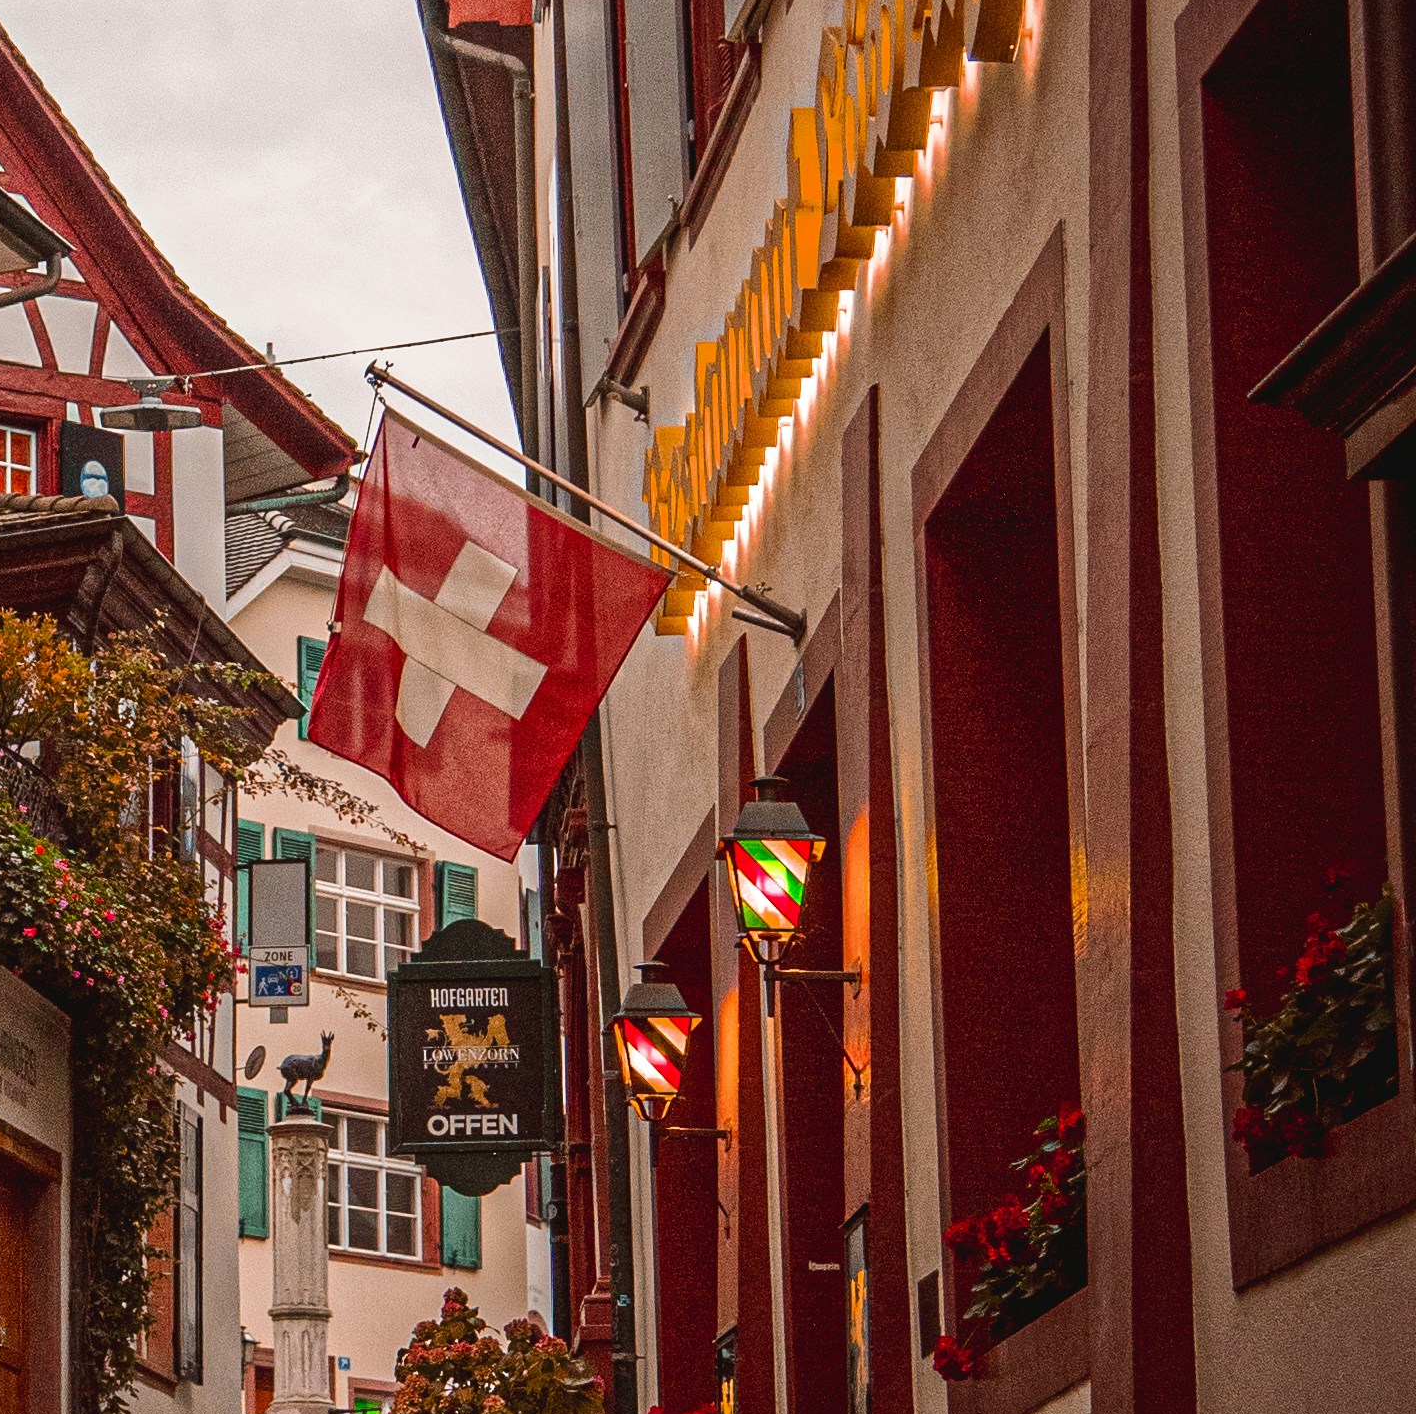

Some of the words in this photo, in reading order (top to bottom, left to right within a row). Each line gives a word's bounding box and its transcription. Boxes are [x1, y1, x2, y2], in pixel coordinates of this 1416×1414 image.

[264, 951, 293, 962] ZONE
[430, 987, 509, 1008] HOFGARTEN
[427, 1114, 519, 1136] OFFEN
